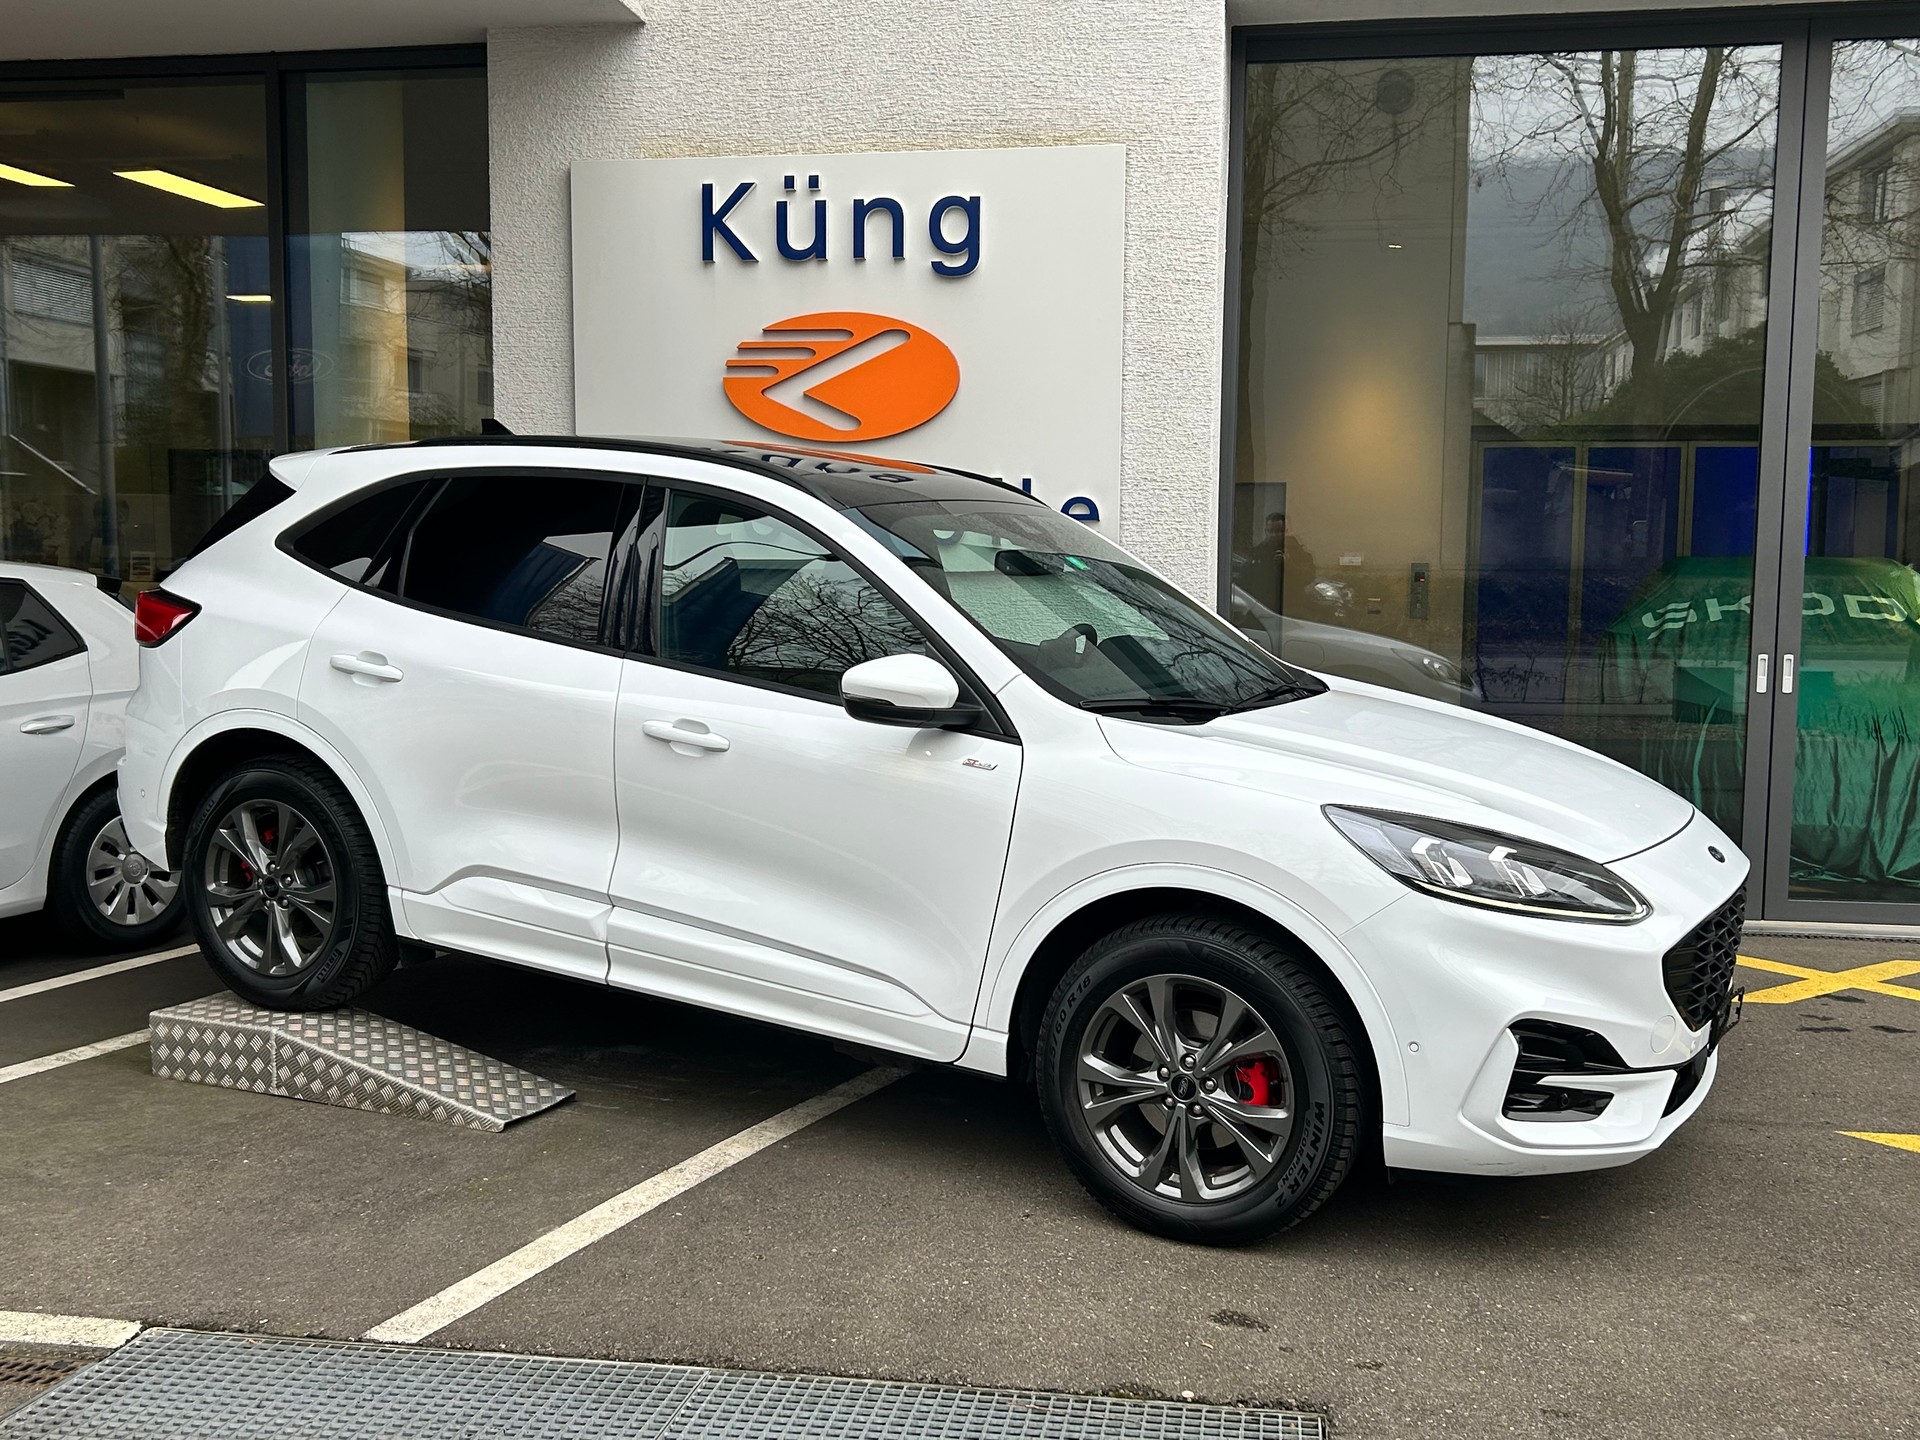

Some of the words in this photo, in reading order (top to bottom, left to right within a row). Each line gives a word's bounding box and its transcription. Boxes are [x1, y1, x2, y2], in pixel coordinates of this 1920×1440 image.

[701, 174, 982, 278] Küng
[1281, 1119, 1311, 1186] SCORPION
[1287, 1101, 1326, 1195] WINTER
